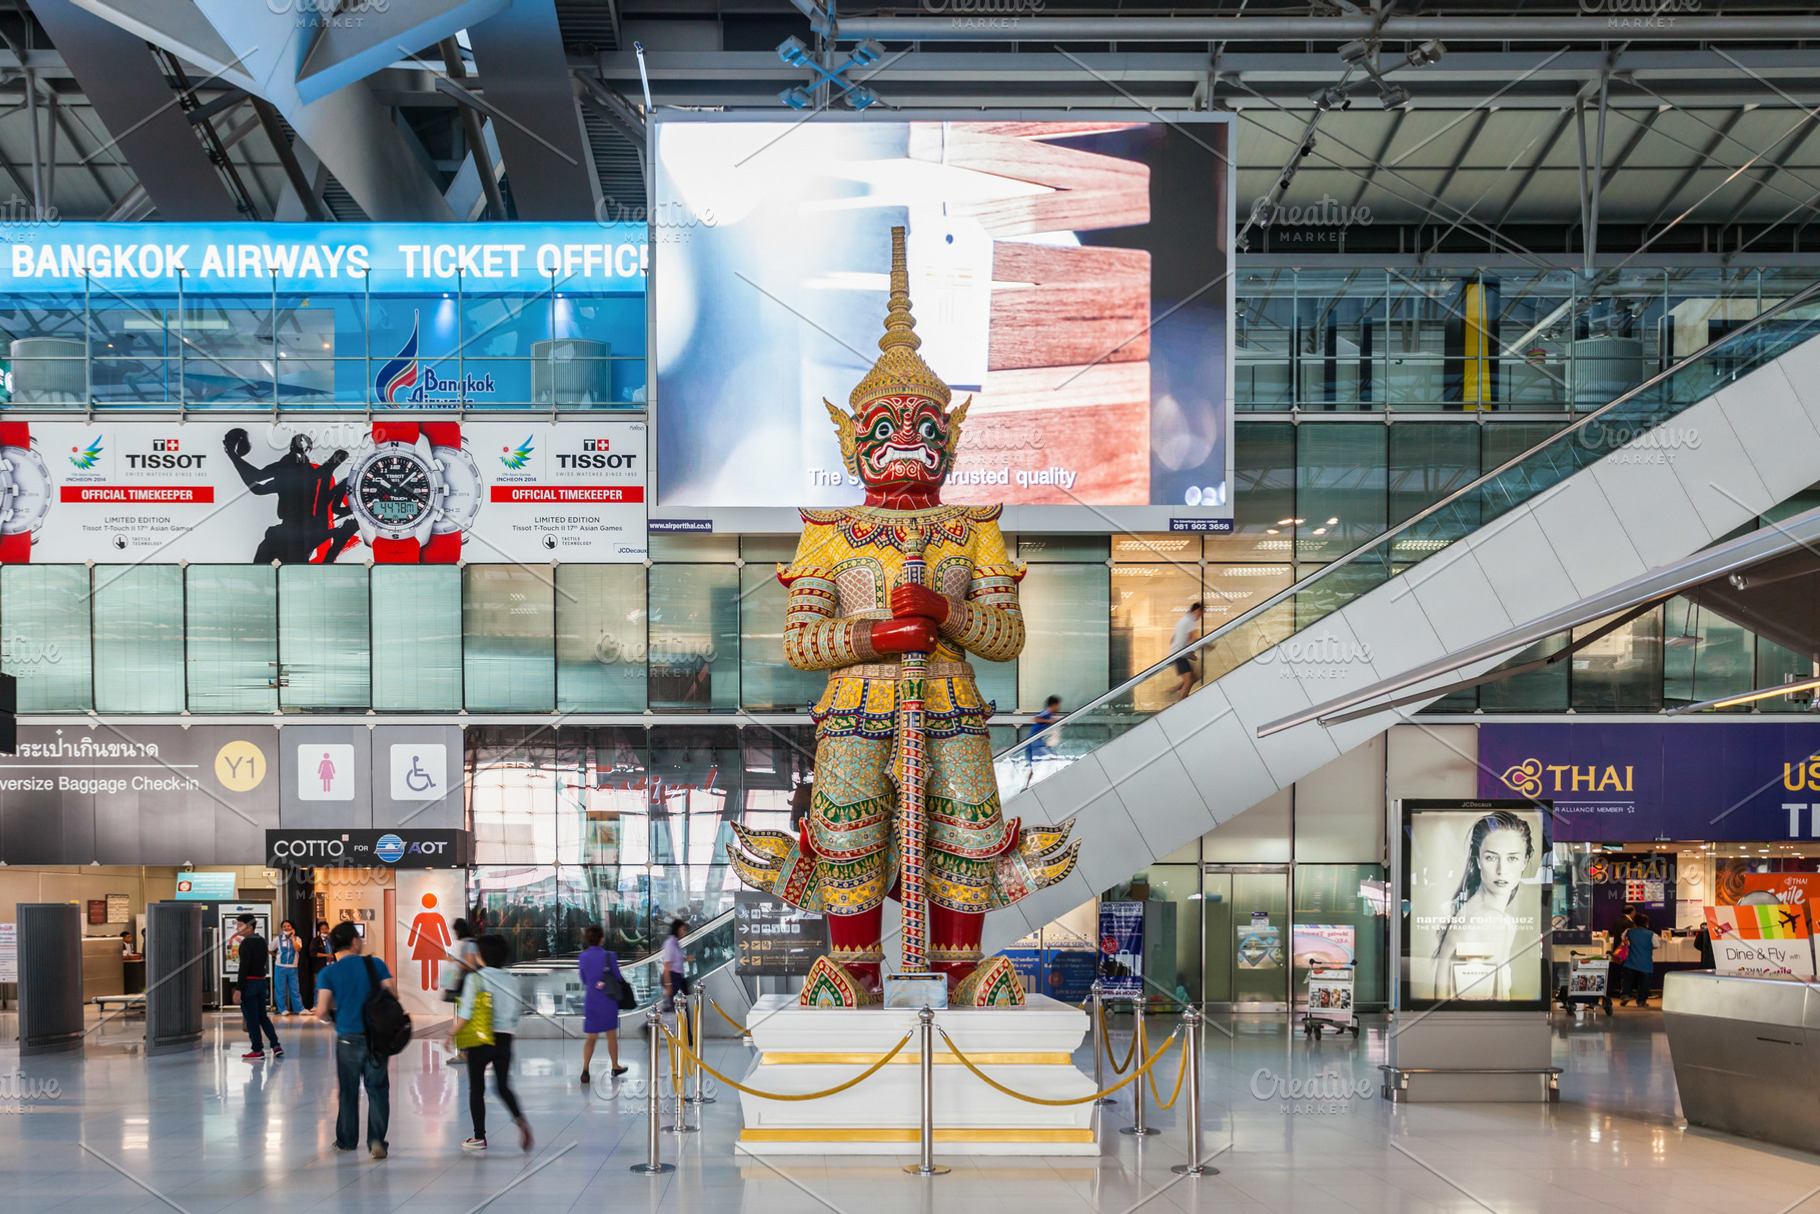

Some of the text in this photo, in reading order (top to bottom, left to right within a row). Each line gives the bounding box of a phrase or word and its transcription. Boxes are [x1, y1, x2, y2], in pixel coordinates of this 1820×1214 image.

[12, 244, 190, 278] BANGKOK
[199, 244, 369, 278] AIRWAYS
[398, 244, 525, 278] TICKET
[424, 365, 495, 397] Bangkok
[126, 455, 206, 468] TISSOT
[556, 455, 636, 468] TISSOT
[809, 469, 843, 486] The
[947, 468, 1009, 485] trusted
[1015, 468, 1076, 489] quality
[82, 490, 193, 500] OFFICIAL TIMEKEEPER
[512, 489, 623, 500] OFFICIAL TIMEKEEPER
[649, 522, 711, 530] www.airportthai.co.th
[0, 728, 159, 757] ระเป๋าเกินขนาด
[224, 756, 256, 779] Y1
[58, 776, 127, 794] Baggage
[131, 776, 199, 791] Check-in
[1546, 764, 1634, 791] THAI
[274, 840, 344, 857] COTTO
[408, 841, 448, 854] AOT
[1610, 860, 1667, 879] THAI
[1416, 914, 1465, 924] narciso
[1725, 948, 1754, 960] Dine
[1757, 948, 1766, 960] &
[1768, 947, 1786, 962] Fly
